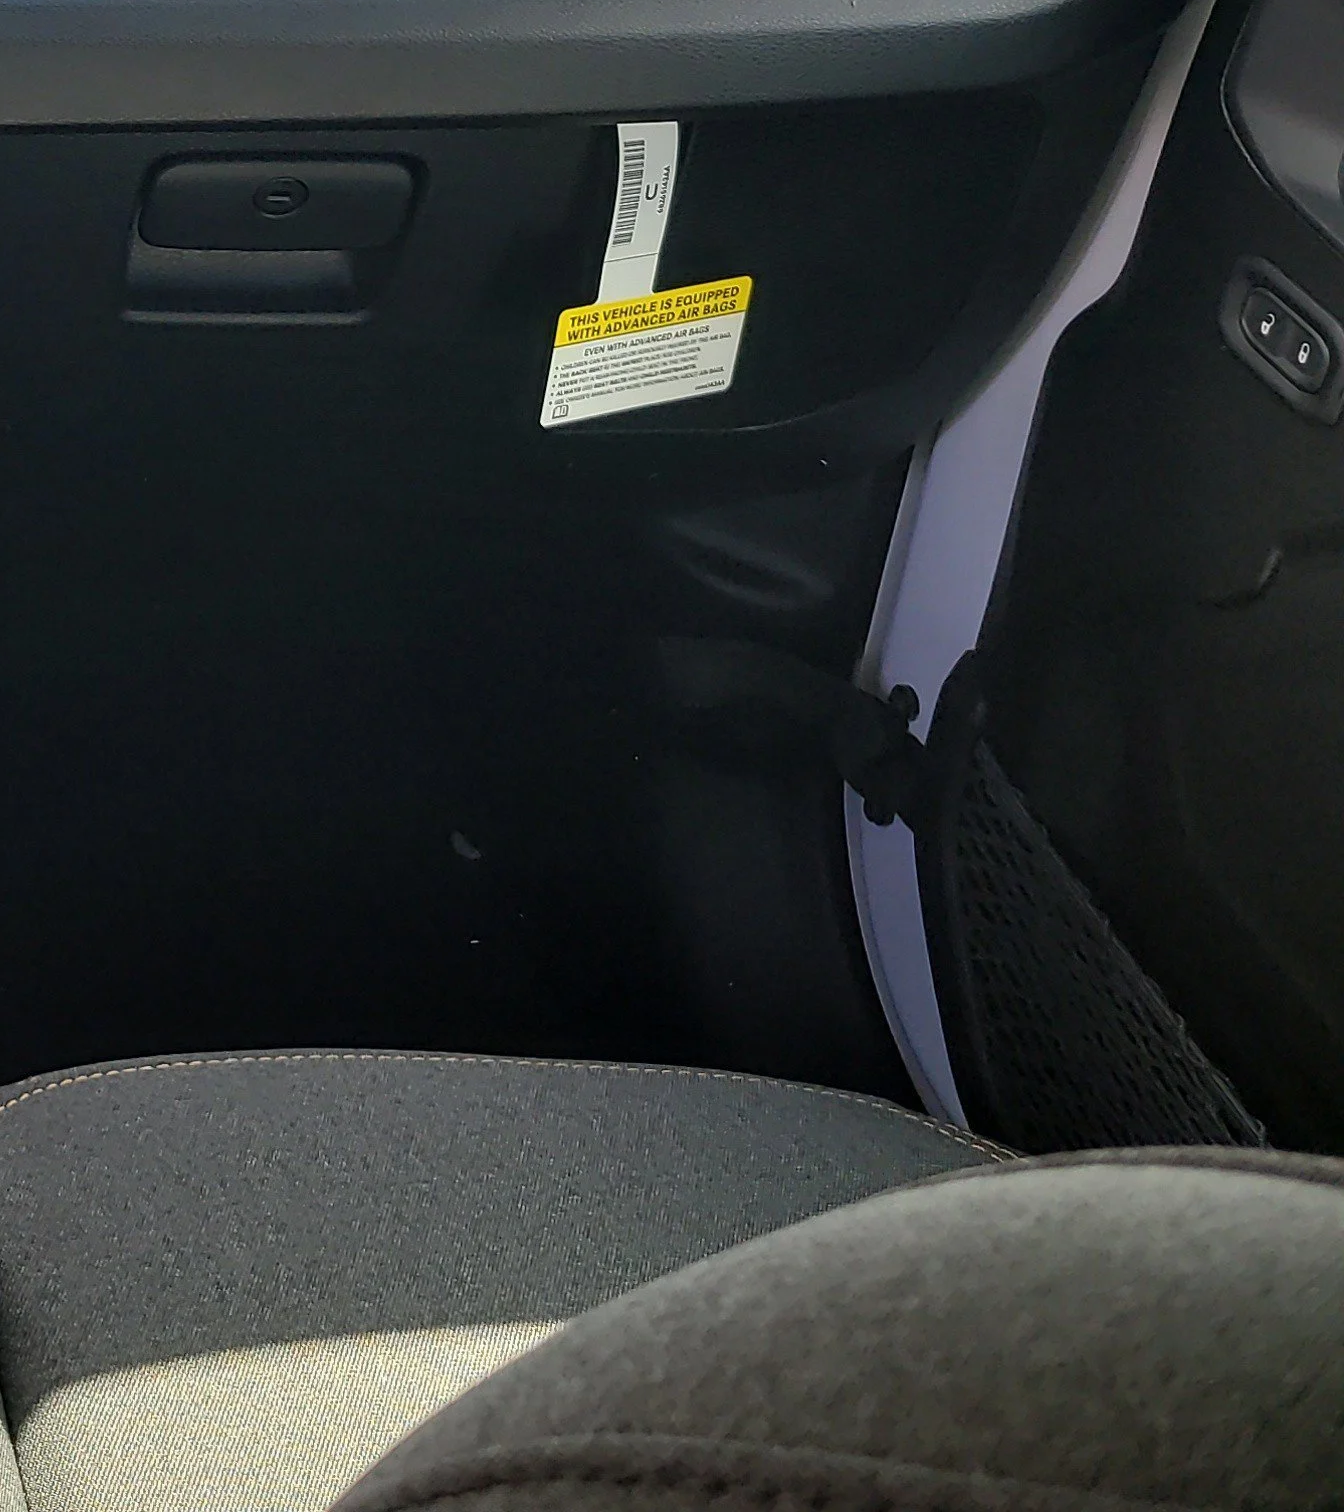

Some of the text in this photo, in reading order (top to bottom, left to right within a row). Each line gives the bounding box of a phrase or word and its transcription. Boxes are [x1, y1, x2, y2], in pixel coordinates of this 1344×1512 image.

[568, 300, 736, 341] WITH ADVANCED AIR BAGS
[570, 286, 739, 327] THIS VEHICLE IS EQUIPPED
[584, 346, 605, 357] EVEN
[607, 342, 628, 352] WITH
